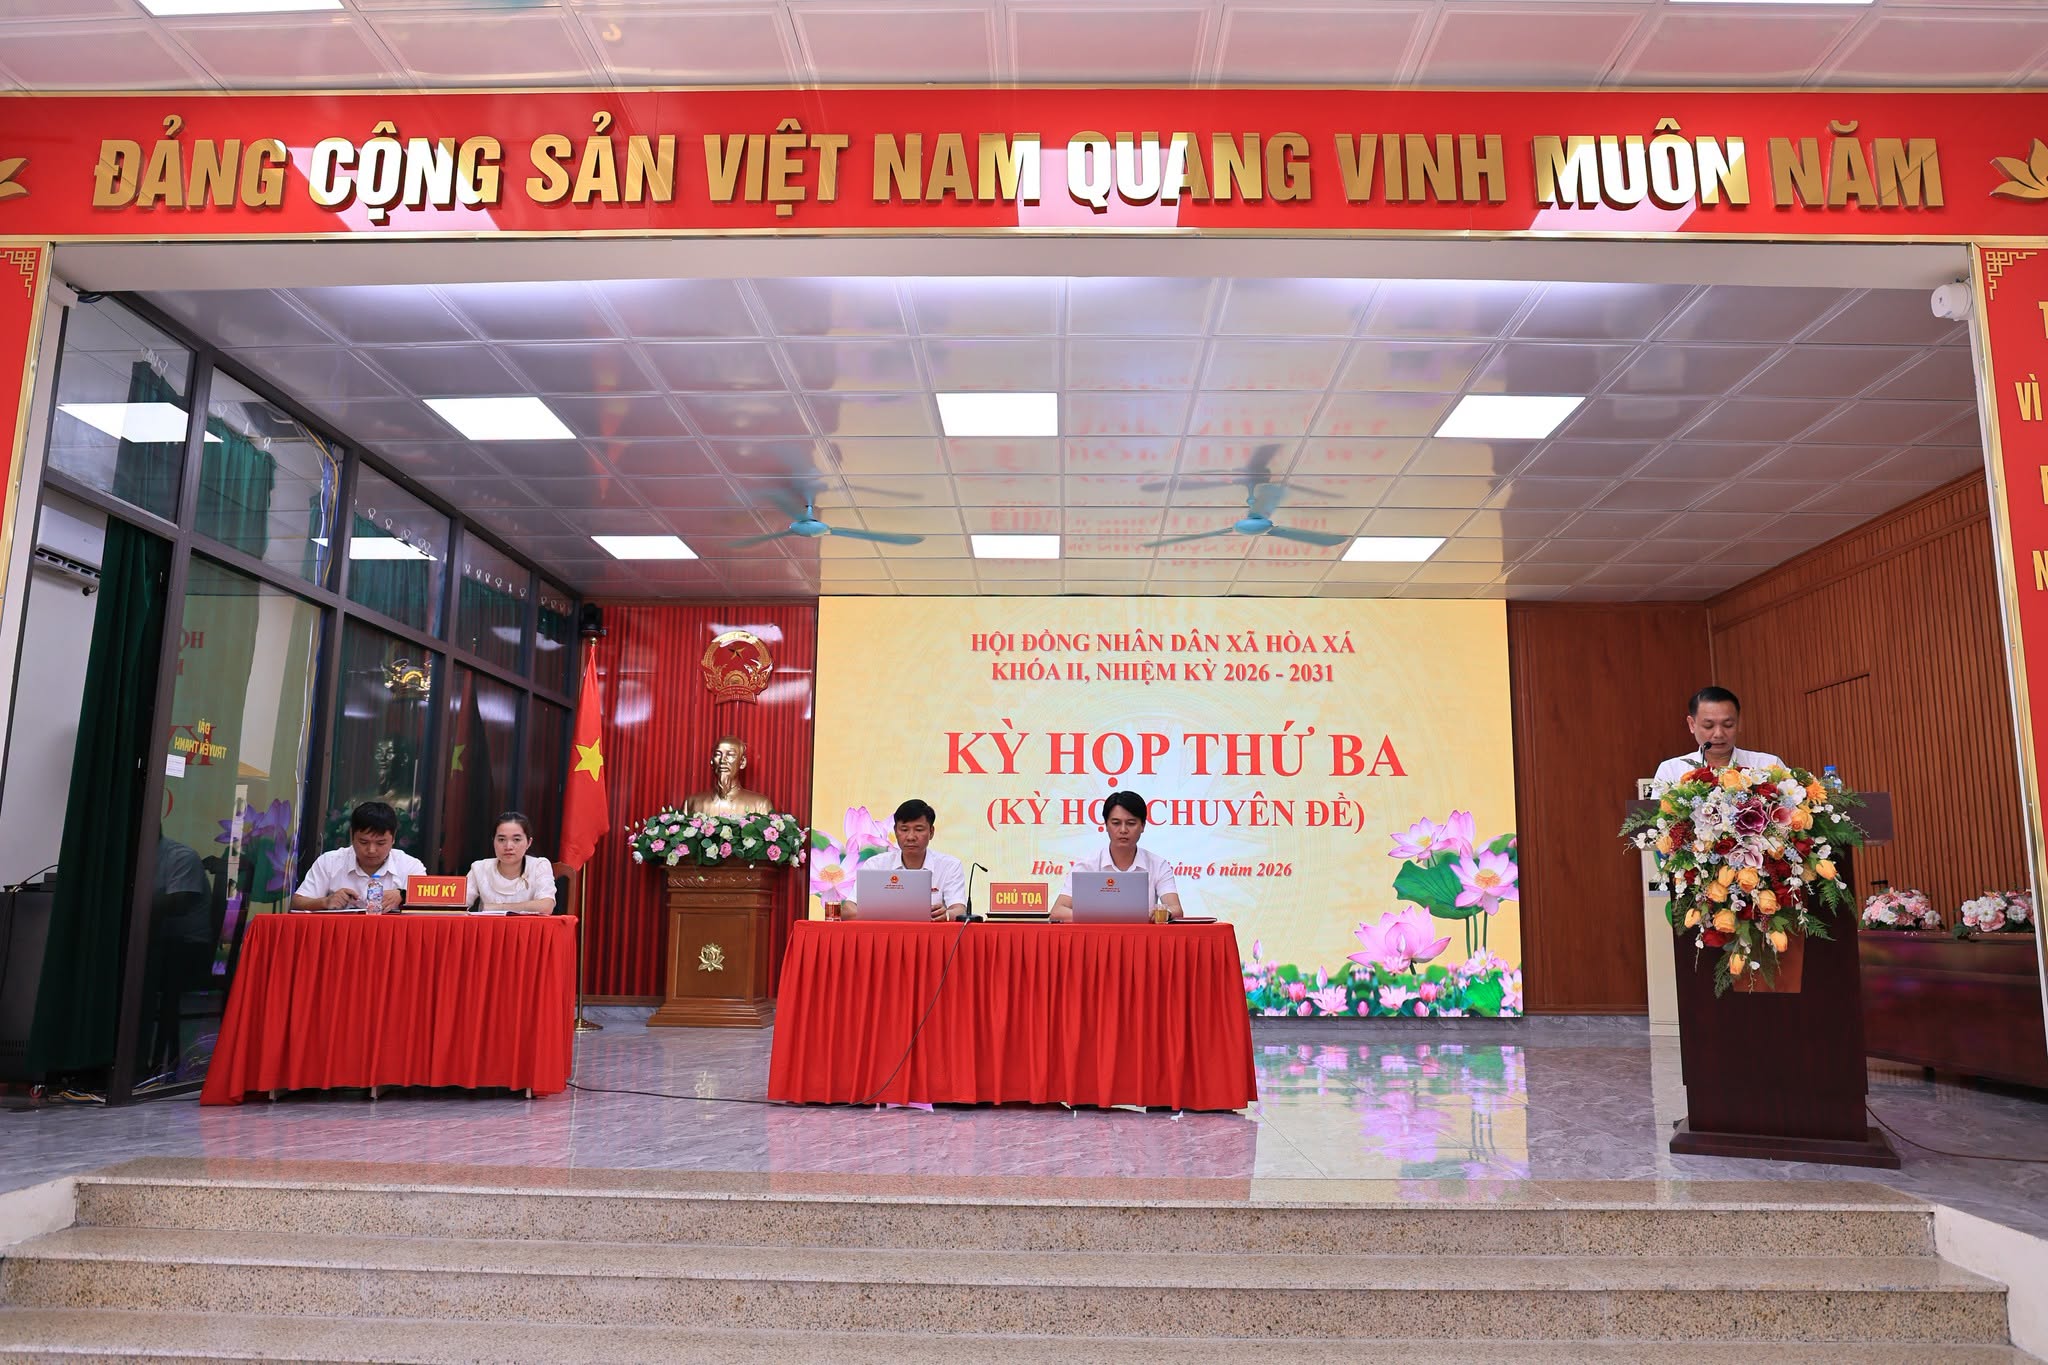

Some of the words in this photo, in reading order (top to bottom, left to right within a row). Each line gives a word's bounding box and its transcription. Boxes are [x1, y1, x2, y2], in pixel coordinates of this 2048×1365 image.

[92, 114, 287, 211] ĐẢNG
[308, 121, 501, 226] CỘNG
[525, 111, 675, 204] SẢN
[703, 118, 849, 217] VIỆT
[873, 132, 1042, 206] NAM
[1066, 131, 1312, 214] QUANG
[1334, 133, 1507, 204] VINH
[1531, 117, 1751, 210] MUÔN
[1768, 119, 1946, 210] NĂM
[2014, 373, 2043, 421] VÌ
[971, 630, 1015, 656] HỘI
[1021, 628, 1091, 652] ĐỒNG
[1096, 627, 1164, 652] NHÂN
[1170, 628, 1219, 652] DÂN
[1226, 630, 1260, 653] XÃ
[1265, 630, 1318, 653] HÒA
[1322, 630, 1356, 653] XÁ
[991, 657, 1061, 681] KHÓA
[1066, 662, 1091, 684] II,
[1096, 660, 1177, 686] NHIỆM
[1183, 658, 1217, 681] KỲ
[1223, 663, 1270, 682] 2026
[1289, 663, 1334, 682] 2031
[943, 718, 1030, 775] KỲ
[1045, 731, 1170, 787] HỌP
[1183, 720, 1315, 777] THỨ
[1328, 733, 1408, 777] BA
[986, 790, 1051, 832] (KỲ
[1060, 798, 1105, 833] HỌ
[1146, 791, 1295, 827] CHUYÊN
[1305, 792, 1365, 834] ĐỀ)
[1031, 860, 1064, 875] Hòa
[1168, 861, 1203, 880] áng
[1206, 862, 1216, 876] 6
[1218, 861, 1253, 877] năm
[1256, 862, 1293, 877] 2026
[417, 884, 440, 897] THƯ
[442, 883, 457, 897] KÝ
[995, 888, 1019, 905] CHỦ
[1021, 892, 1043, 907] TỌA
